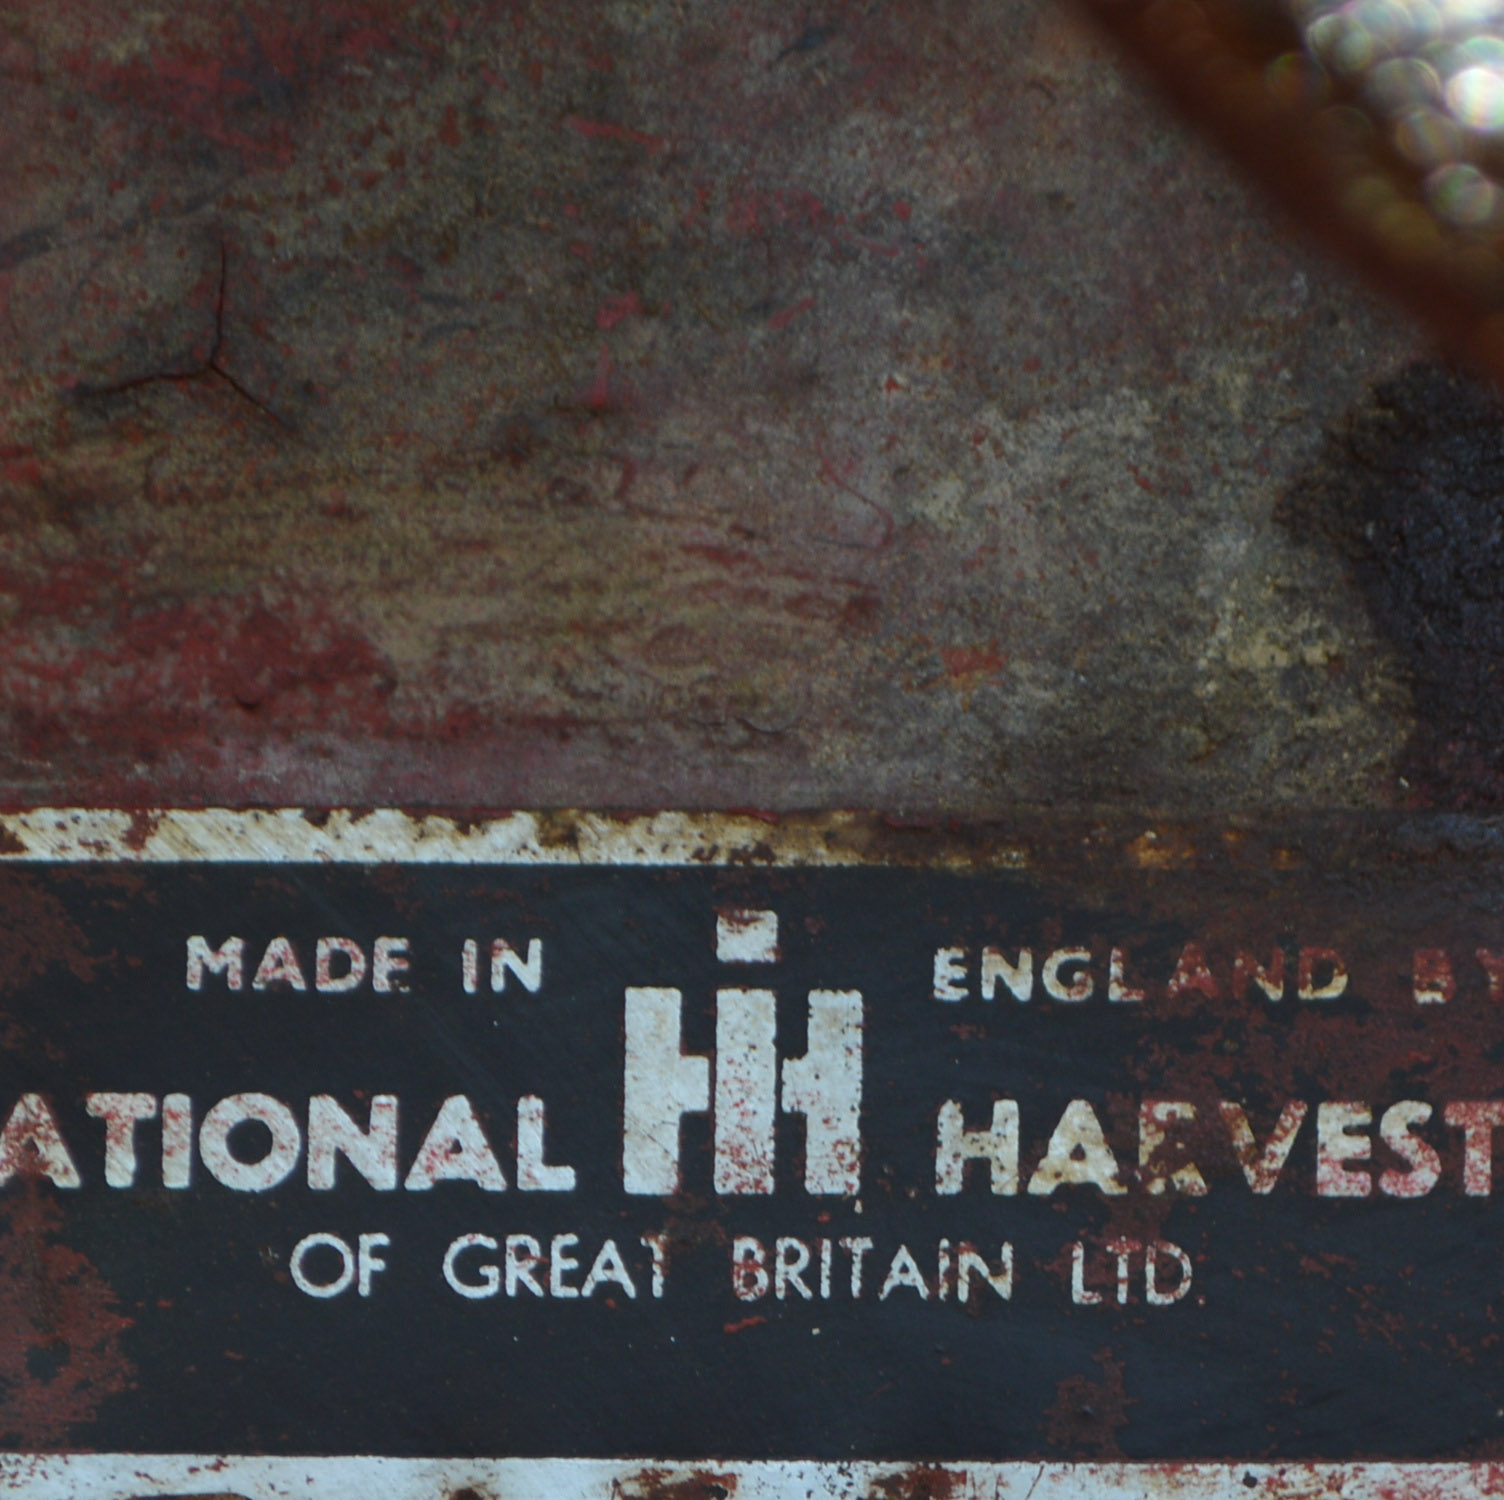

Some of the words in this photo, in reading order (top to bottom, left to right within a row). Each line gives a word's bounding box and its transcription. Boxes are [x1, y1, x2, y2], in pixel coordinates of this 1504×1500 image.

[184, 934, 410, 993] MADE
[462, 936, 544, 993] IN
[931, 945, 1349, 1003] ENGLAND
[290, 1231, 392, 1298] OF
[441, 1232, 669, 1299] GREAT
[730, 1236, 1015, 1304] BRITAIN
[1069, 1240, 1195, 1307] LTD
